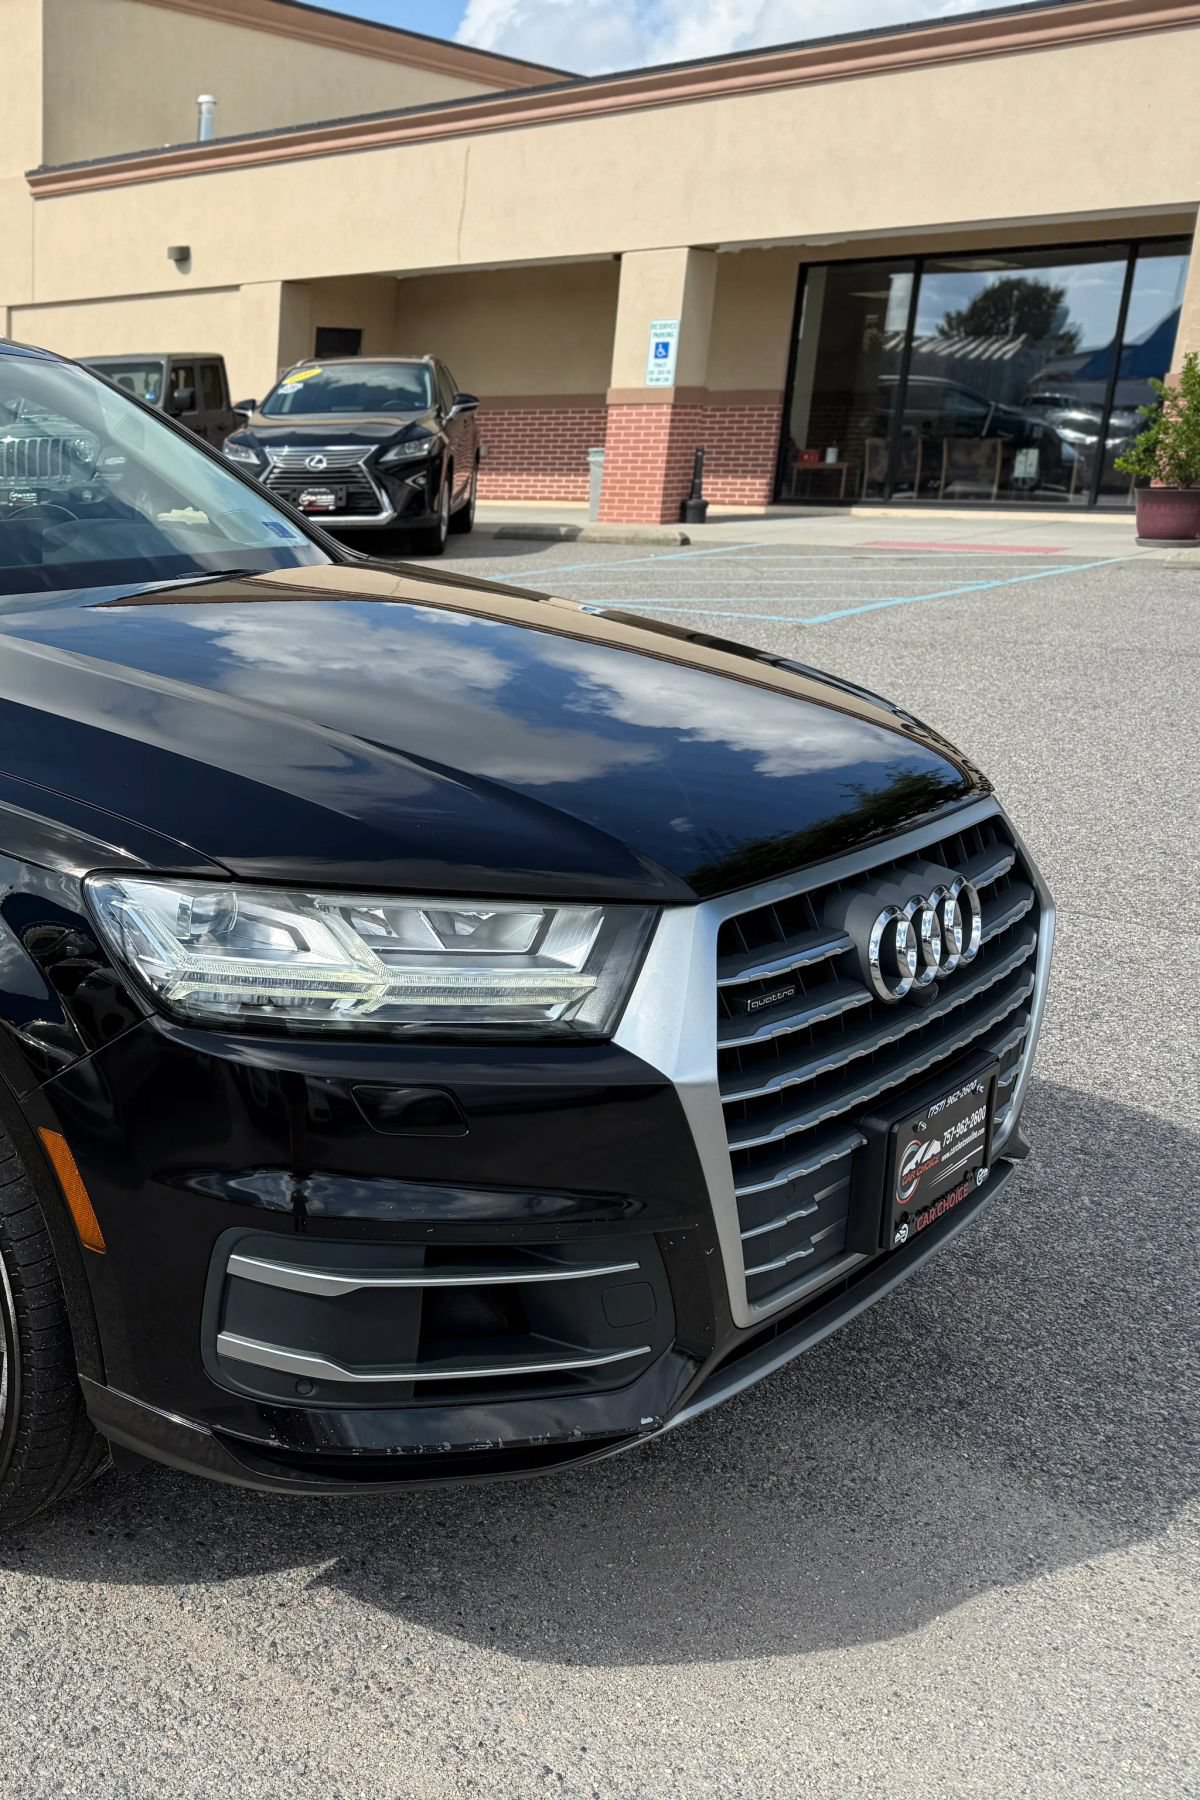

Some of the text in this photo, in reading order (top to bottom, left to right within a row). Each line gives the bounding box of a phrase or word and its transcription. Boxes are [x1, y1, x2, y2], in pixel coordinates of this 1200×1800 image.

[751, 988, 794, 1009] quattro
[943, 1105, 987, 1147] 757-962-2600
[902, 1154, 941, 1186] CAR CHOICE
[916, 1182, 969, 1231] CAR CHOICE
